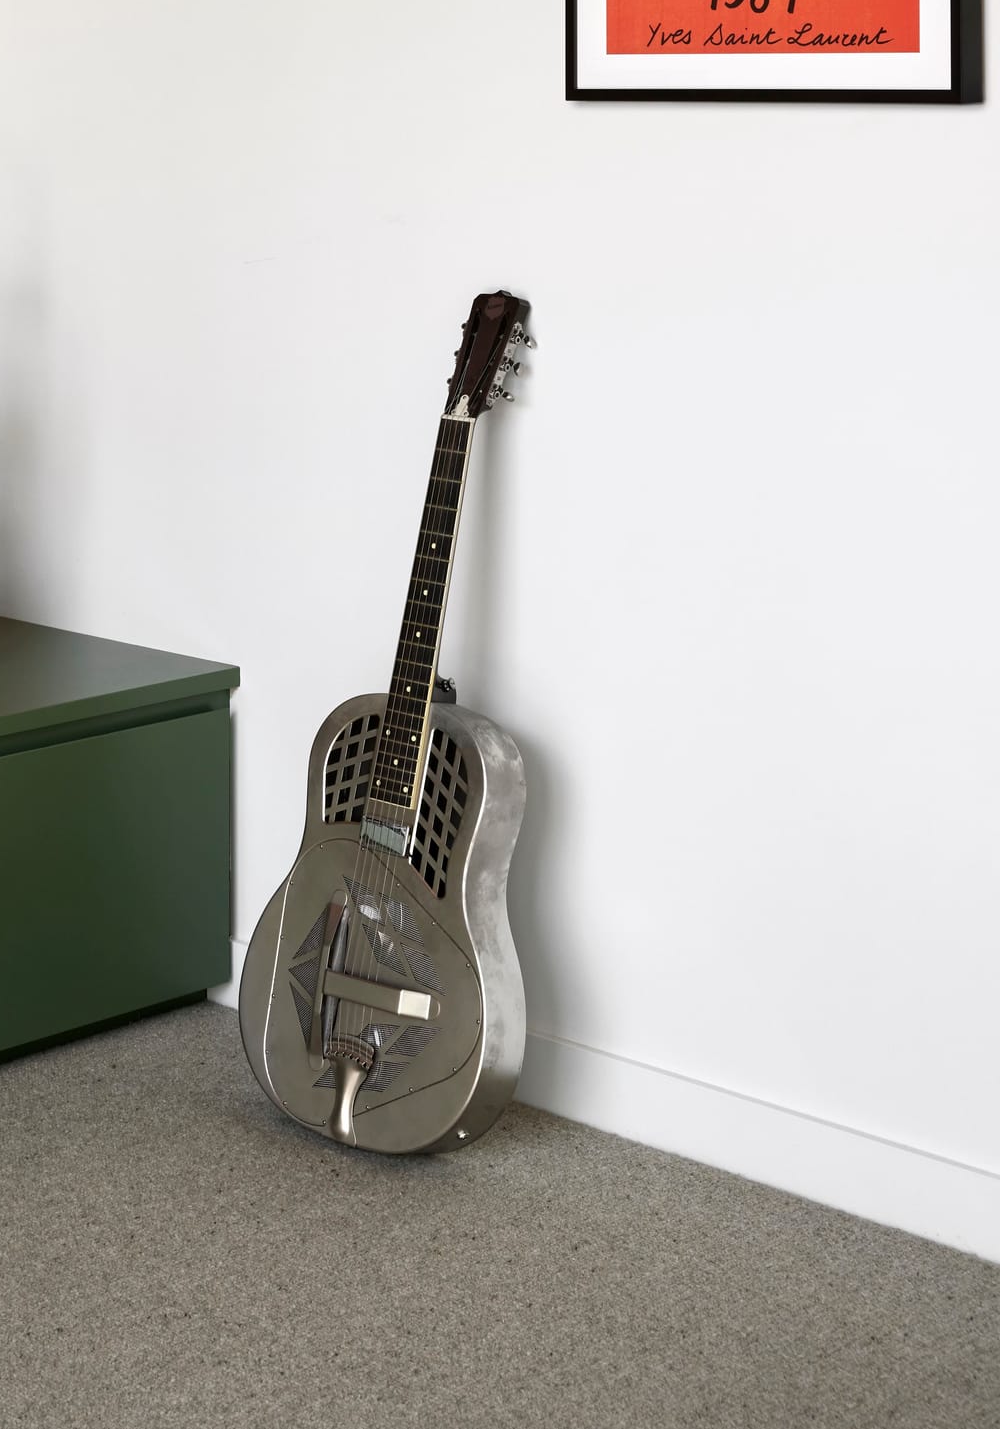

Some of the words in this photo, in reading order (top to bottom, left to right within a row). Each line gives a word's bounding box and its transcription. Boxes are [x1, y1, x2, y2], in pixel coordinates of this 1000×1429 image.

[646, 22, 692, 47] Yves
[703, 23, 783, 47] Saint
[786, 22, 895, 47] Laurent
